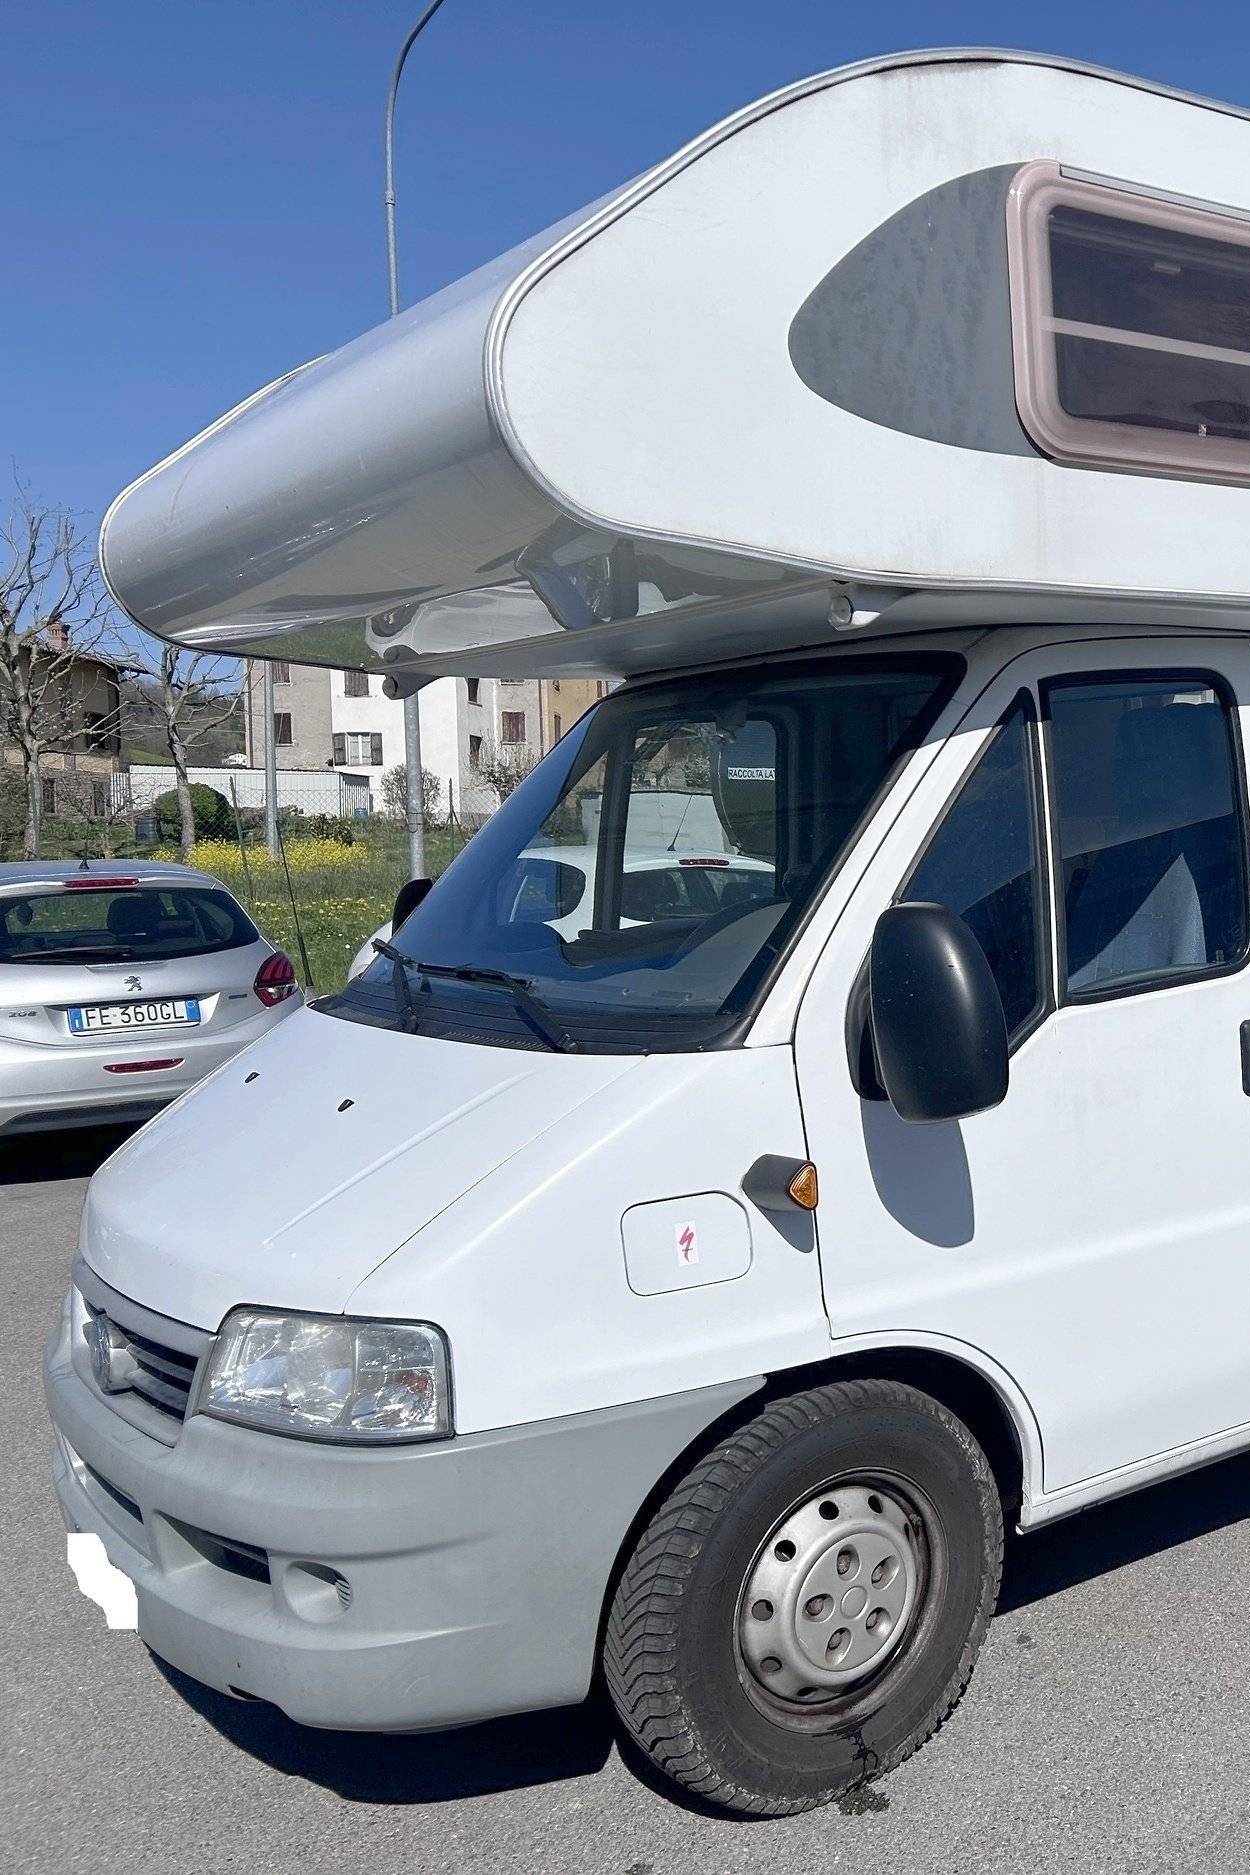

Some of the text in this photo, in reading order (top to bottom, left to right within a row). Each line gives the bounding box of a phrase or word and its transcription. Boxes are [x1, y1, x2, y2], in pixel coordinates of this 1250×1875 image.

[728, 769, 764, 779] RACCOLTA
[8, 1010, 38, 1018] 208
[85, 1001, 185, 1027] FE 360GL
